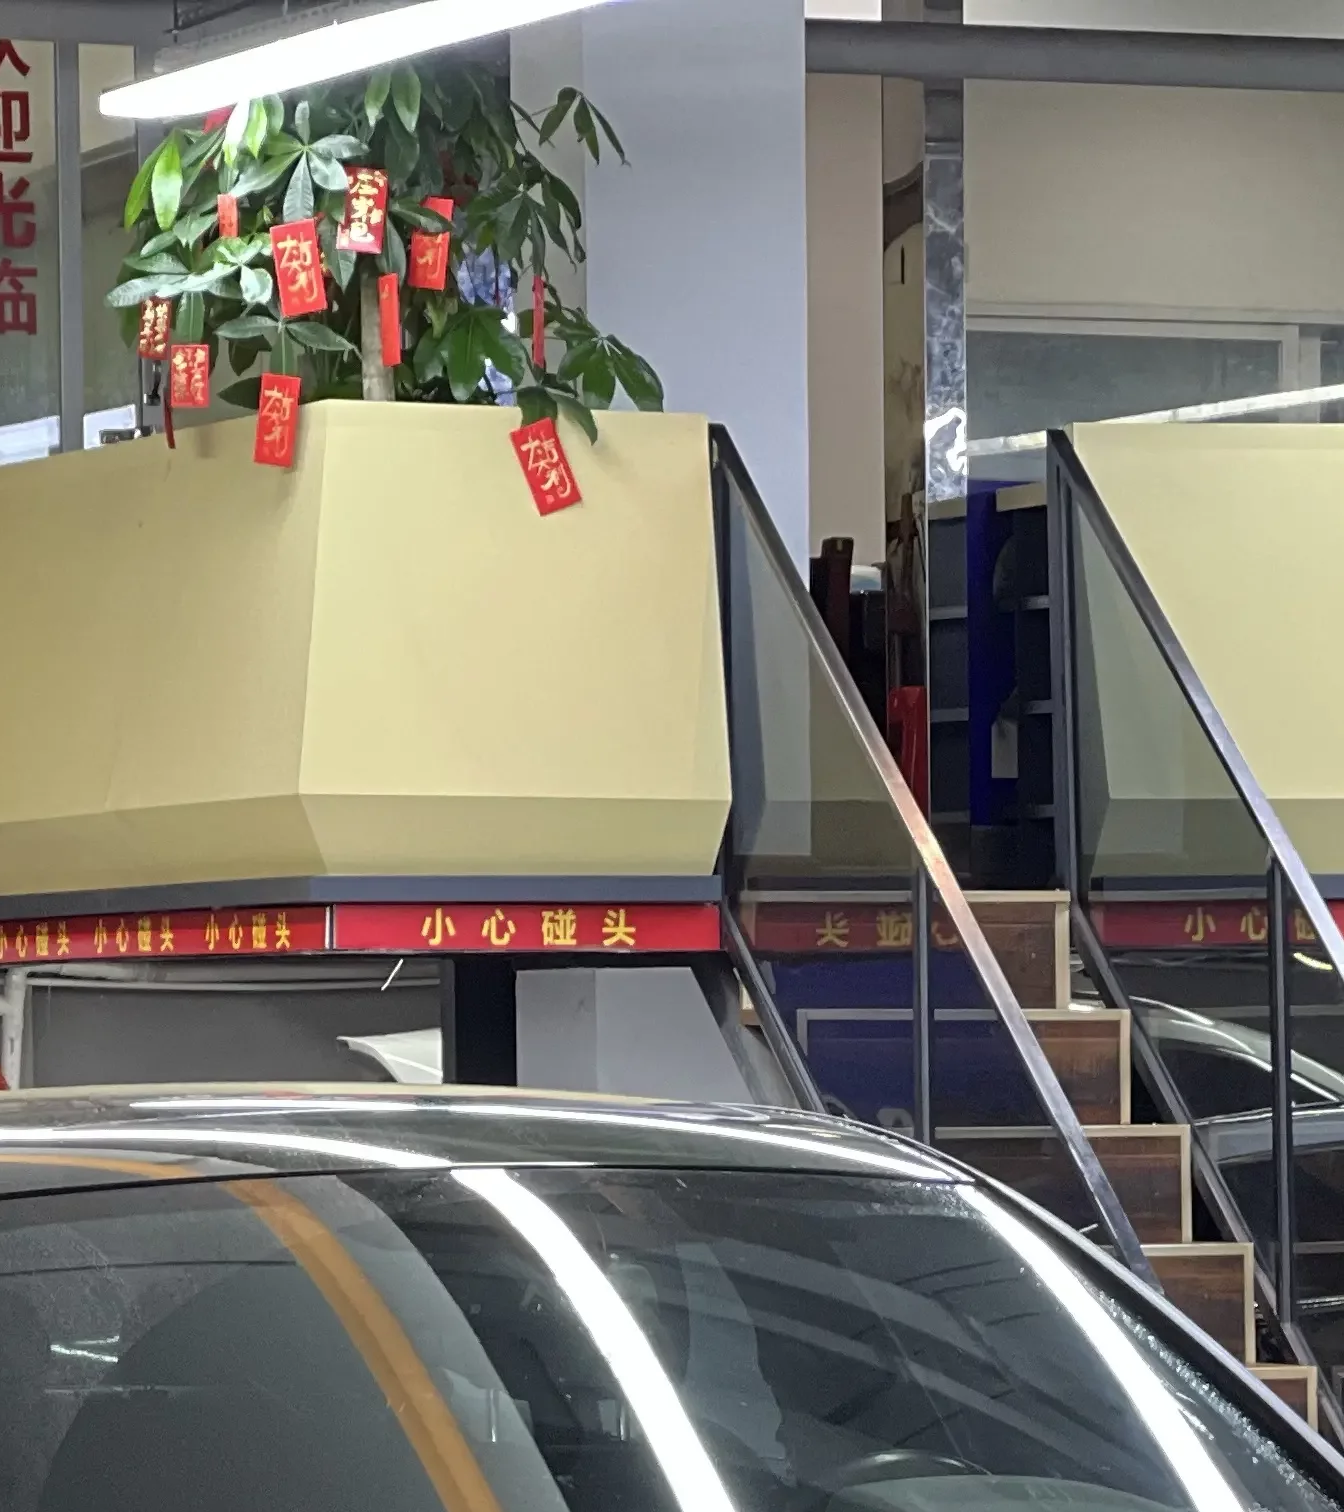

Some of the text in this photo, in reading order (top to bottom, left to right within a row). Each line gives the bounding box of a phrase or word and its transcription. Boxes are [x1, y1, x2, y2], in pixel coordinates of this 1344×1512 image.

[94, 914, 175, 954] 小心碰头
[205, 911, 291, 952] 小心碰头
[421, 907, 637, 947] 小心碰头
